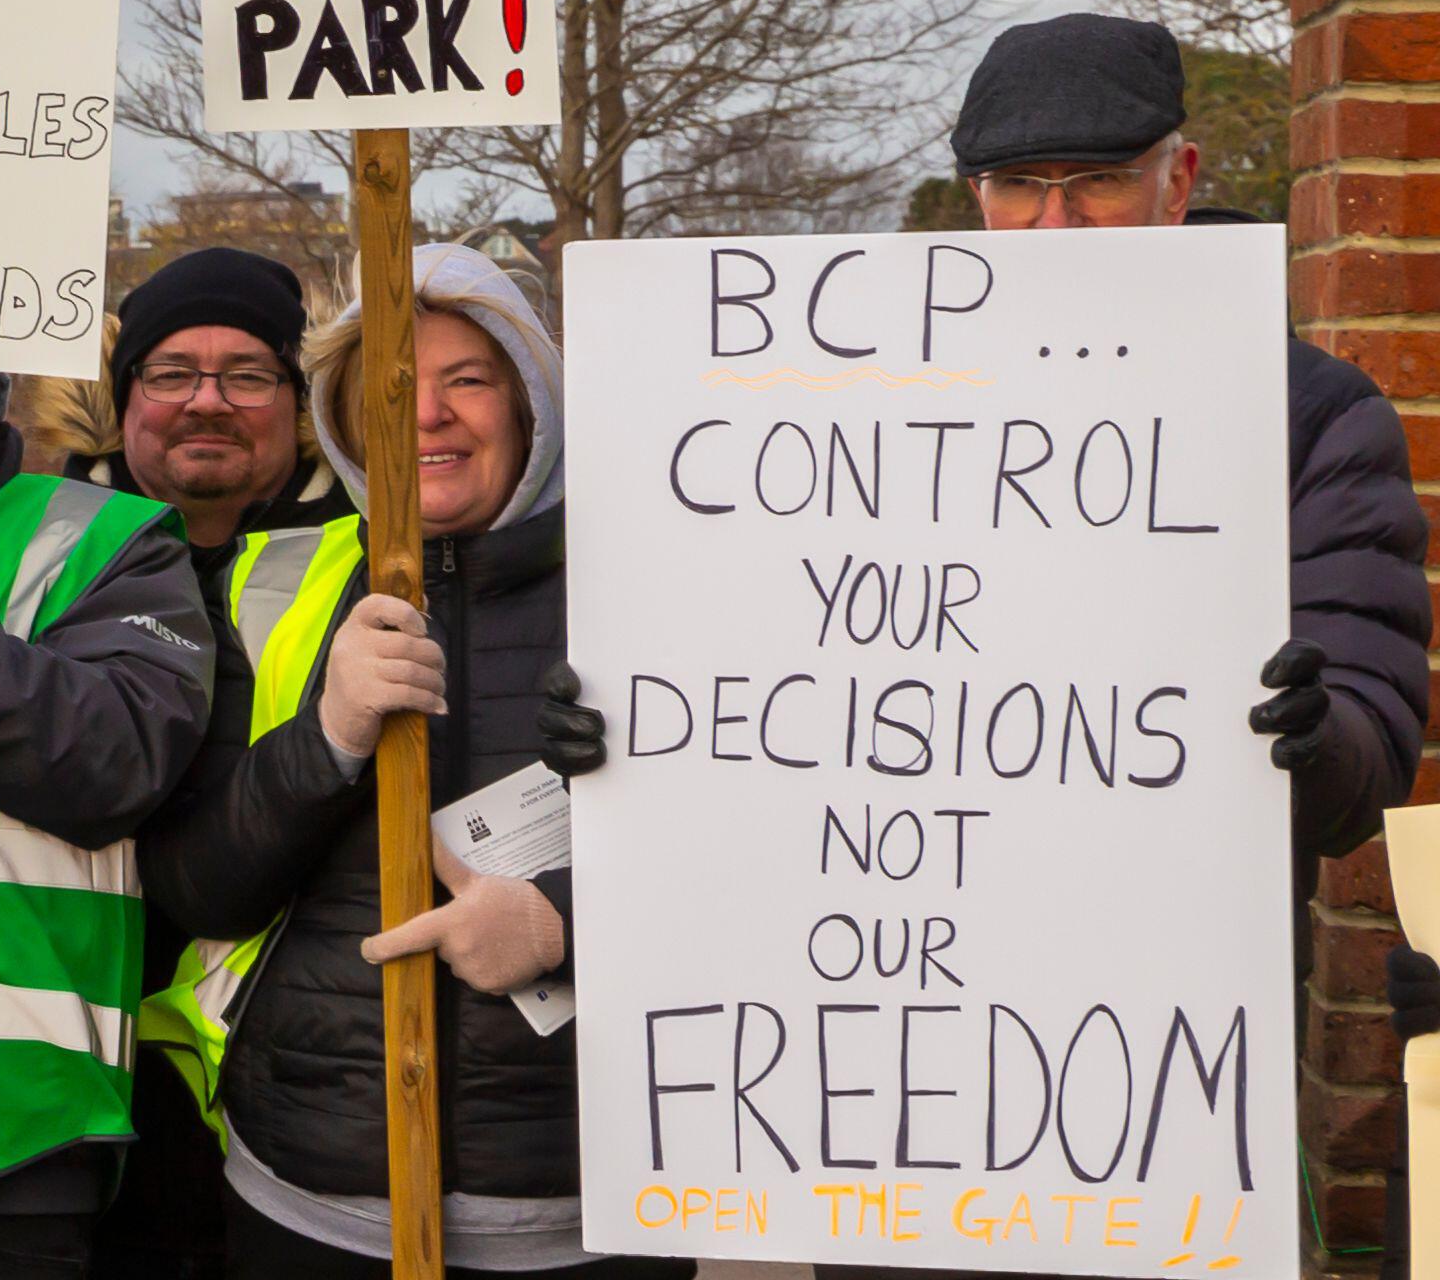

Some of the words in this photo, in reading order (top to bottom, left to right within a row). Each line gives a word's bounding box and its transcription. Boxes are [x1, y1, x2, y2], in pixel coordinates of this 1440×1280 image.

[669, 417, 1220, 533] CONTROL
[120, 614, 201, 651] MUSTO
[801, 552, 982, 655] YOUR
[629, 673, 1190, 789] DECISIONS
[820, 804, 990, 890] NOT
[807, 912, 965, 989] OUR
[644, 1003, 1256, 1192] FREEDOM
[634, 1184, 769, 1236] OPEN
[812, 1184, 924, 1241] THE
